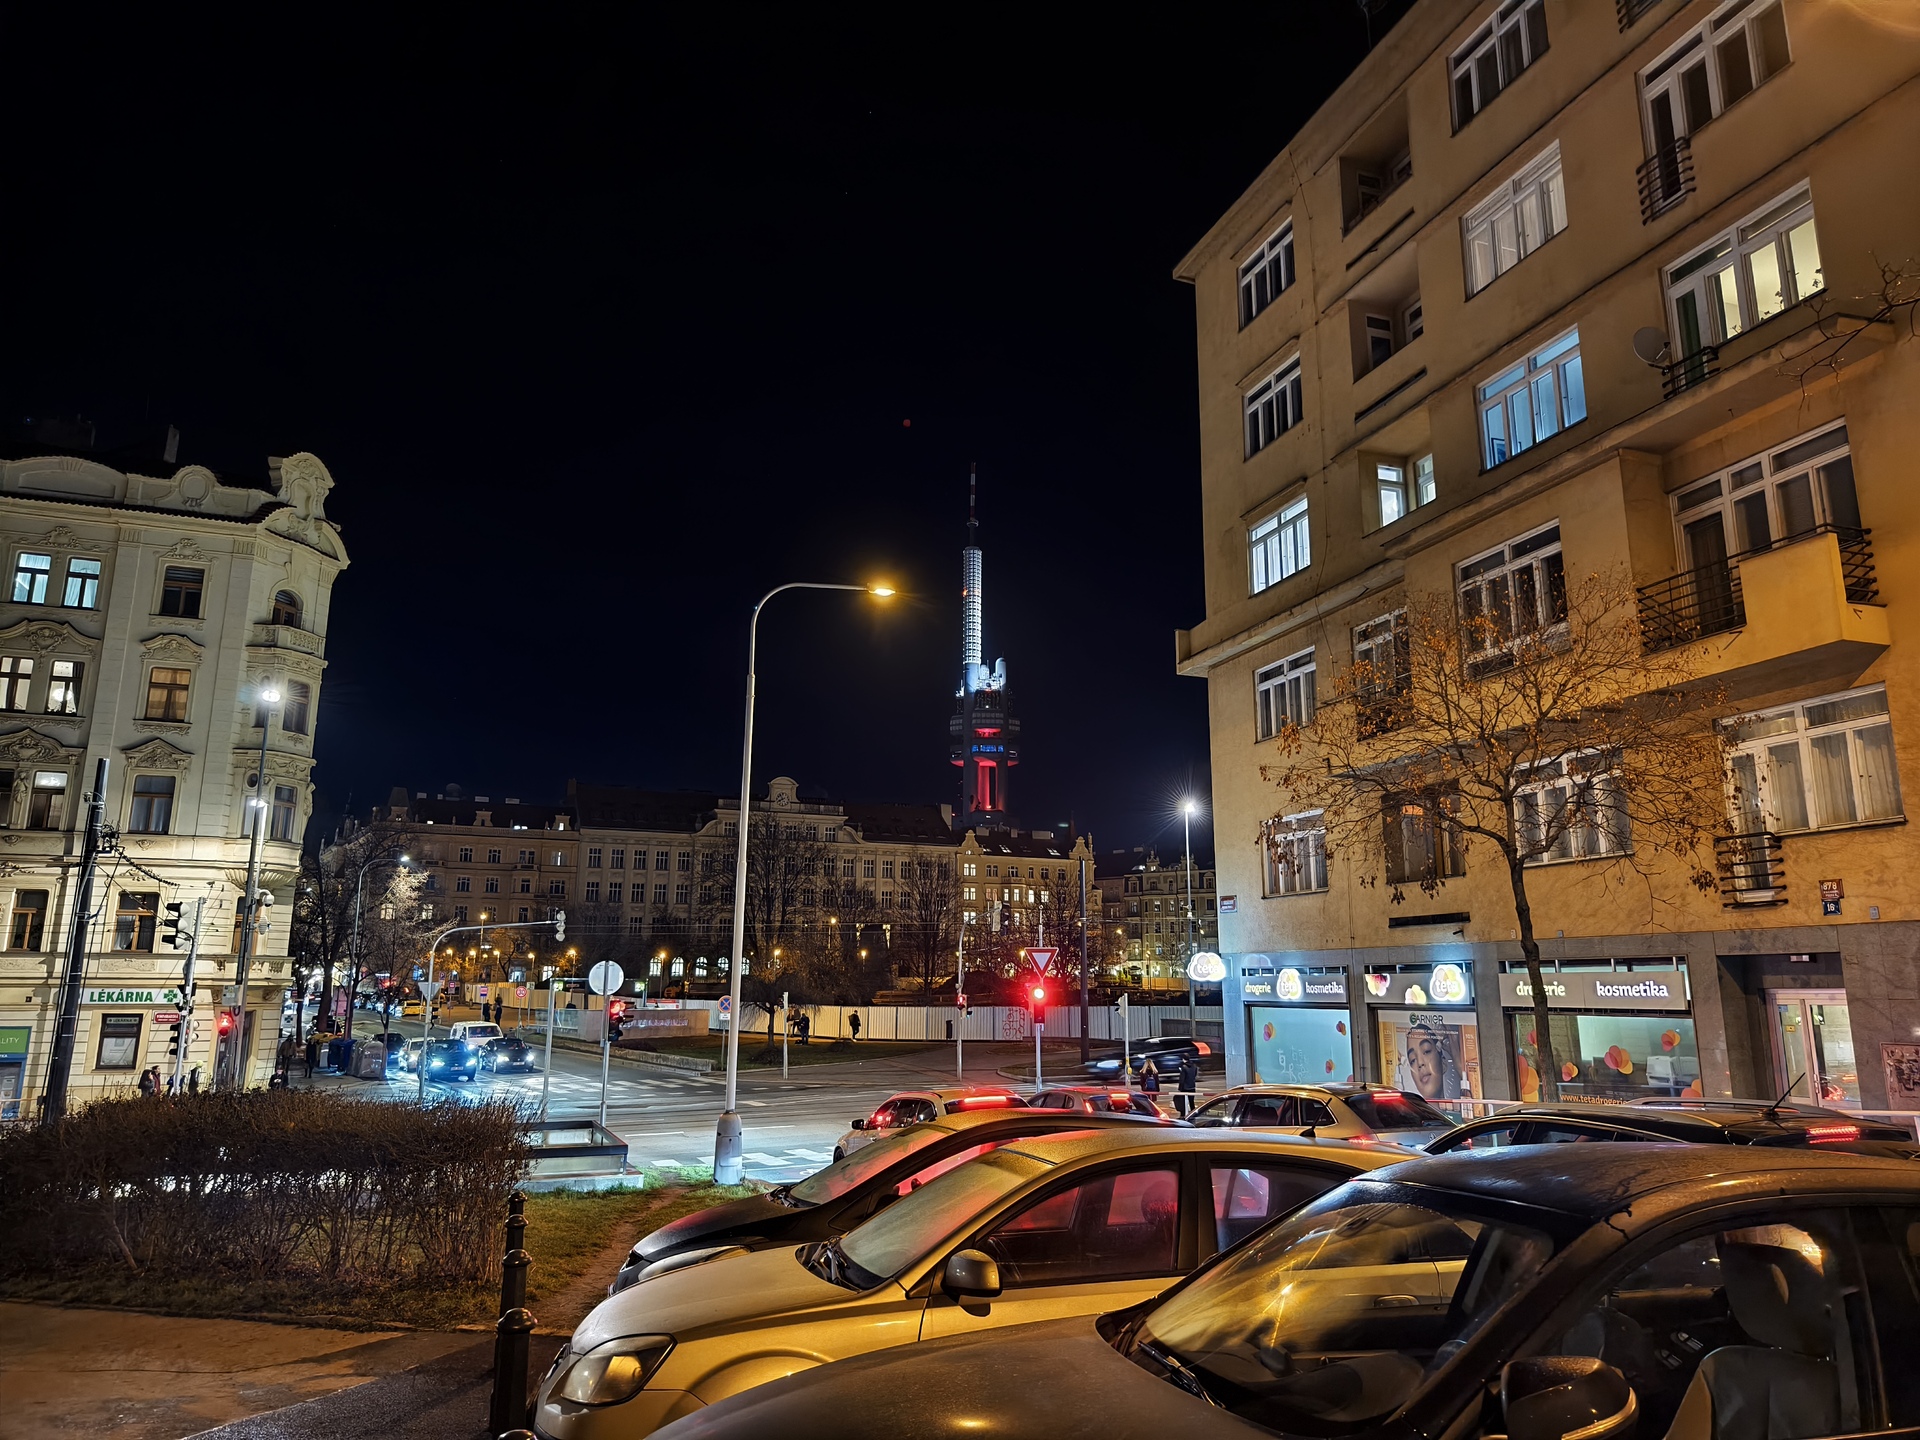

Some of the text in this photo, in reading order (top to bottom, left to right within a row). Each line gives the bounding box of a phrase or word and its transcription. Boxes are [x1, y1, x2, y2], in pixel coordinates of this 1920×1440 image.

[1823, 882, 1837, 890] 878
[1827, 903, 1835, 911] 16
[1245, 982, 1271, 995] drogerie
[1305, 981, 1344, 994] kosmetika
[1435, 979, 1459, 992] teta
[1516, 981, 1669, 997] droerie kosmetika
[89, 989, 153, 1003] LÉKÁRNA
[1409, 1012, 1444, 1025] GARNIER
